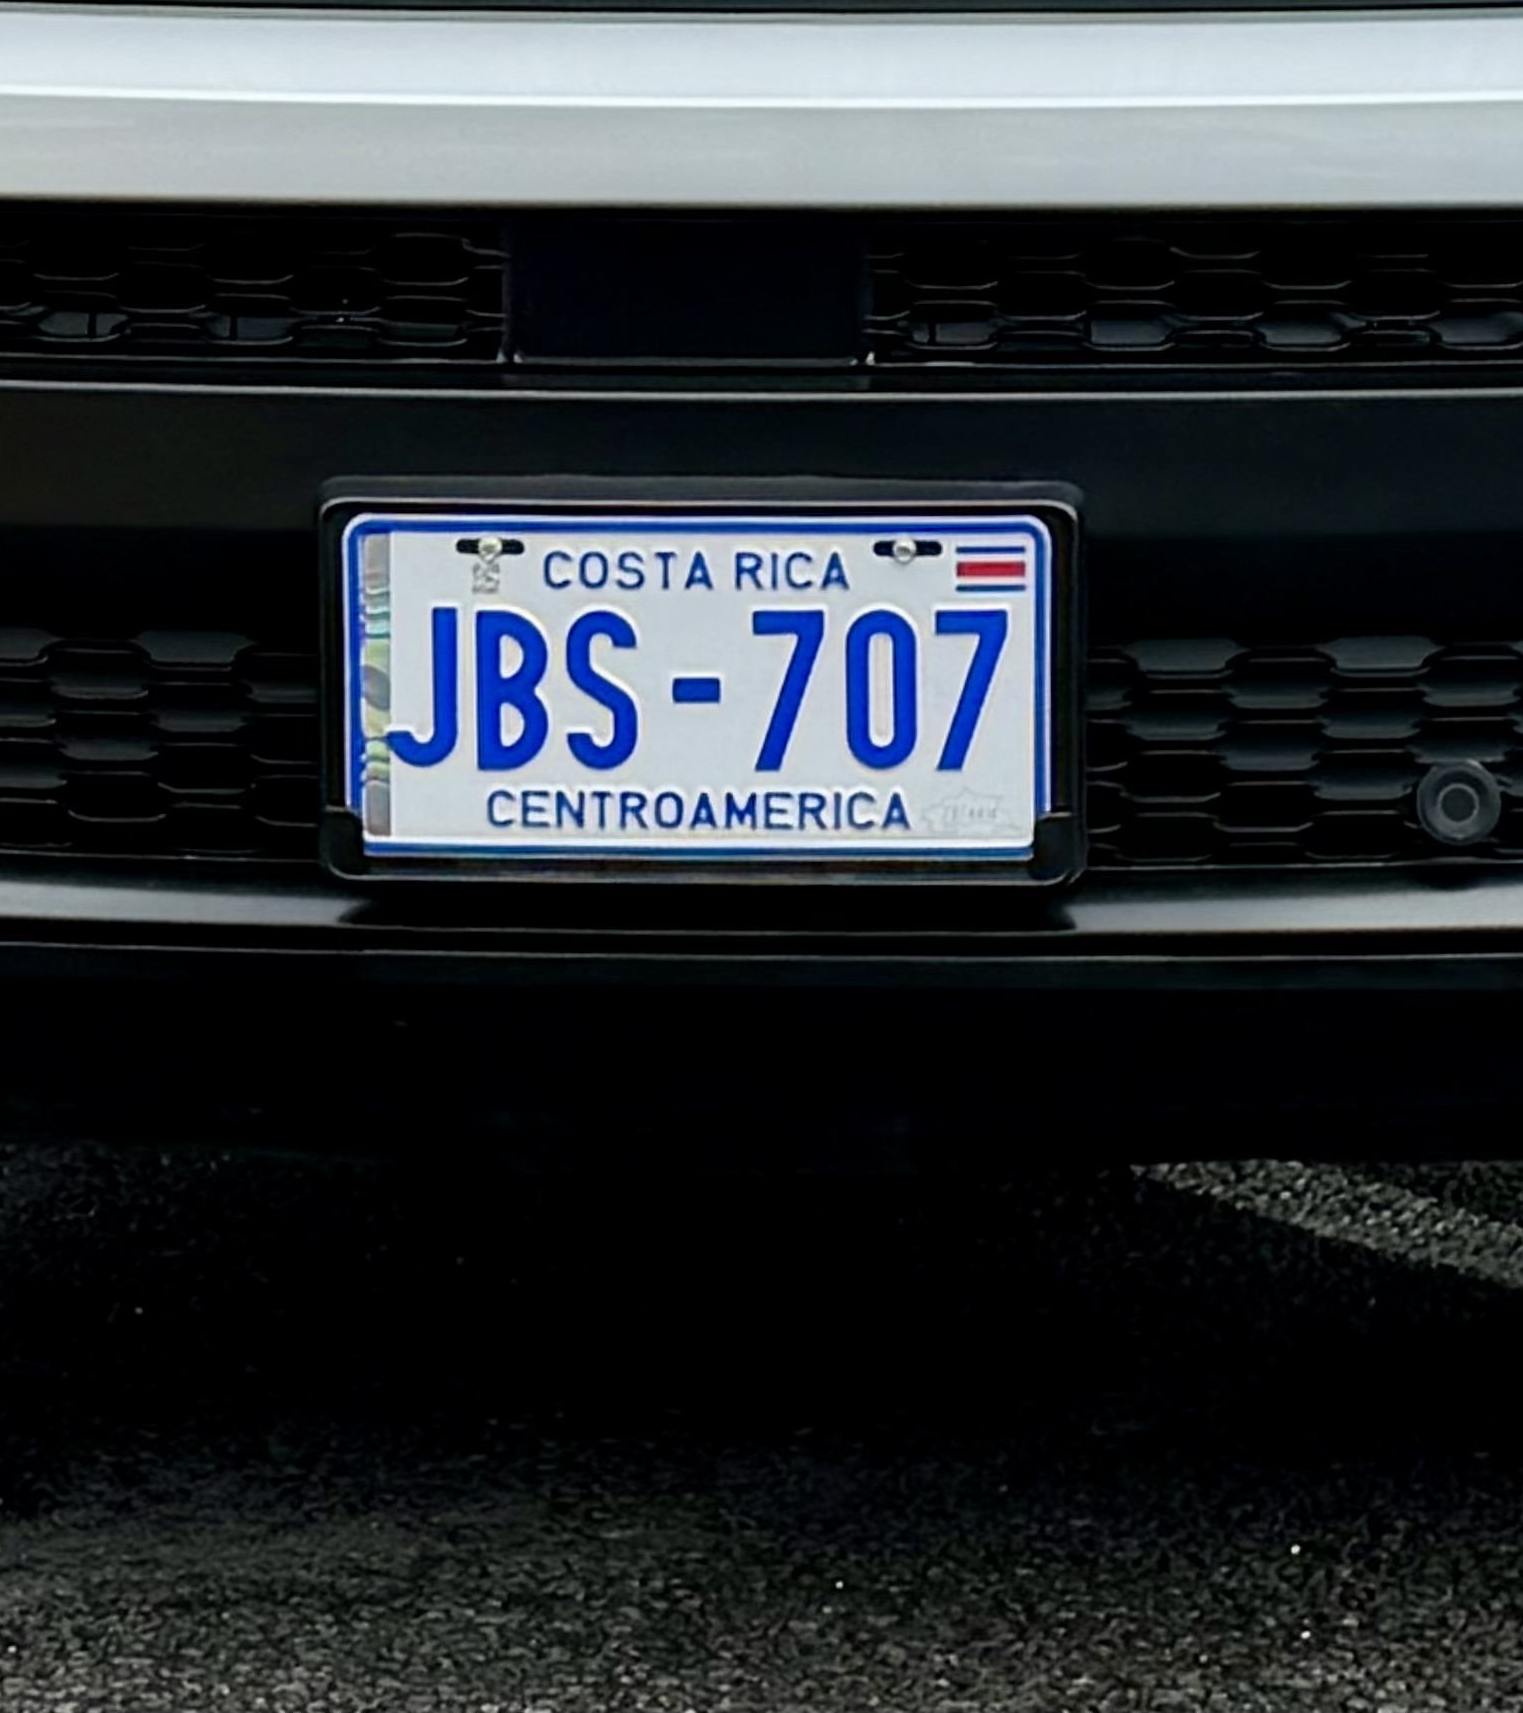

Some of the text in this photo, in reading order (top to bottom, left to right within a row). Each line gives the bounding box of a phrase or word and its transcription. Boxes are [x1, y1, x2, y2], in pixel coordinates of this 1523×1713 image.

[542, 550, 850, 590] COSTA RICA
[388, 606, 1009, 770] JBS-707
[486, 789, 911, 831] CENTROAMERICA
